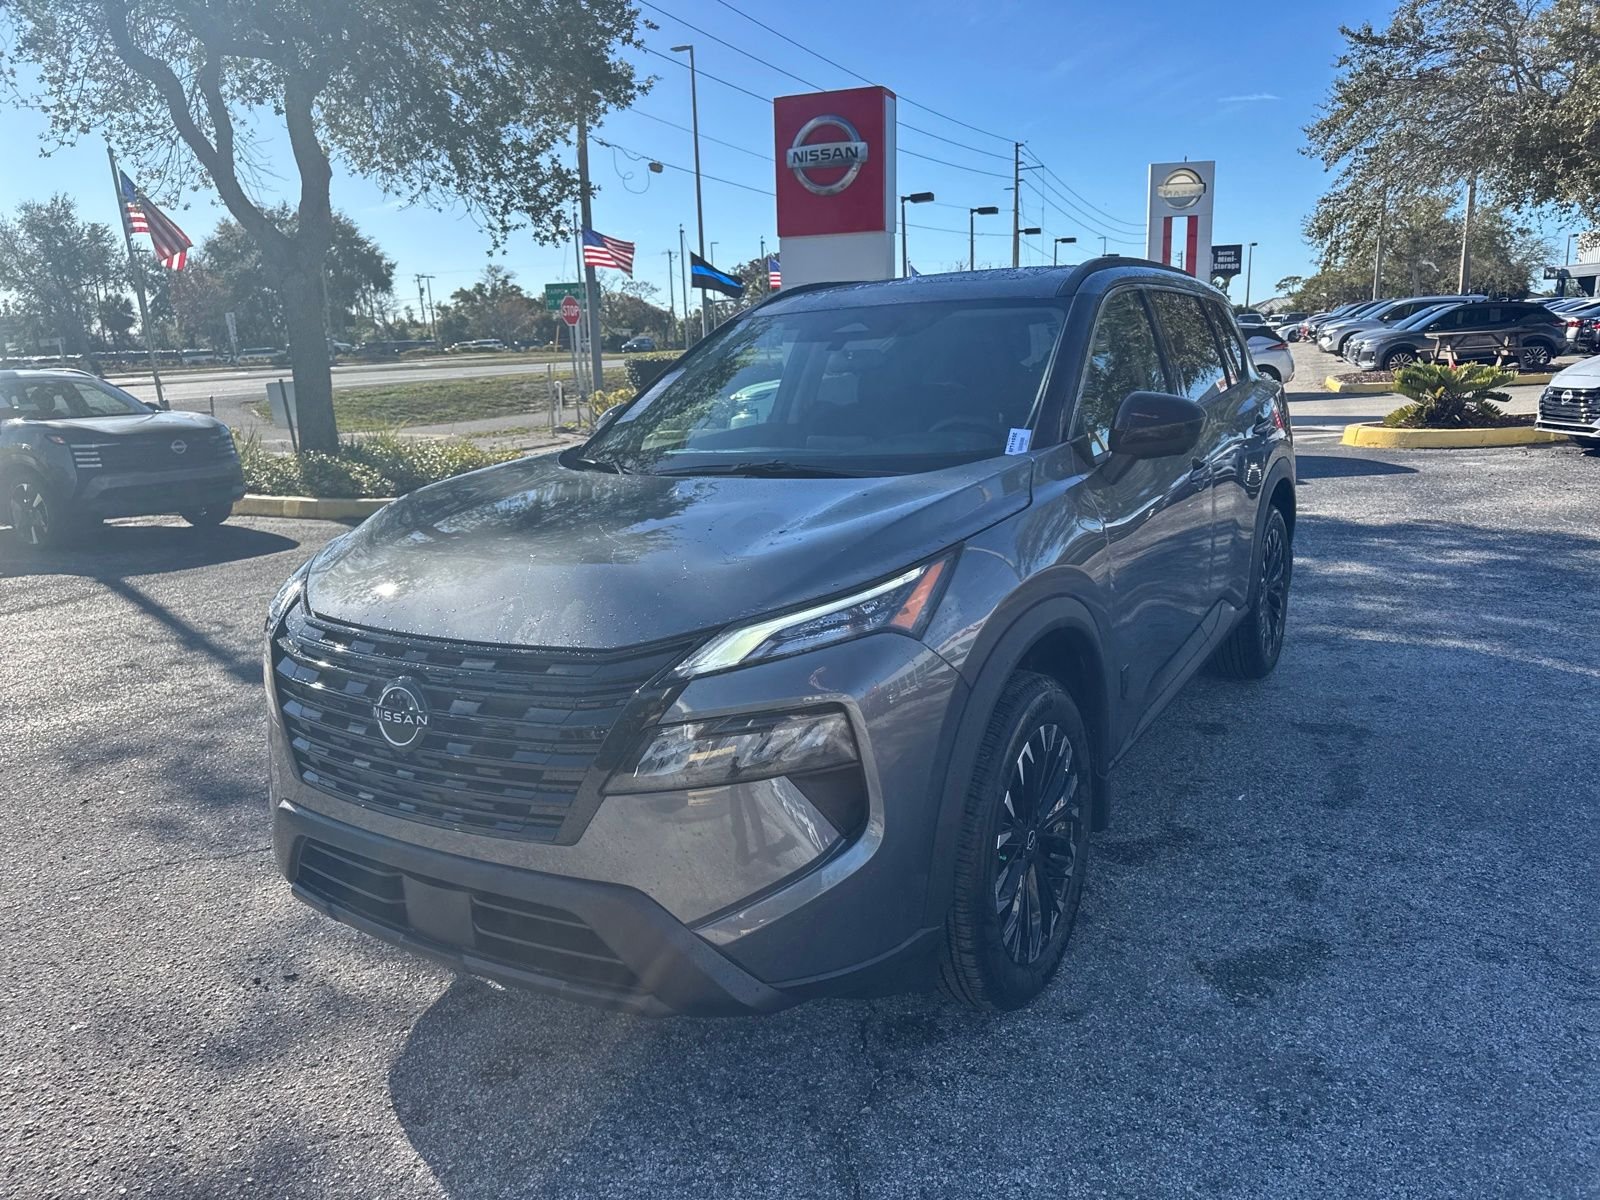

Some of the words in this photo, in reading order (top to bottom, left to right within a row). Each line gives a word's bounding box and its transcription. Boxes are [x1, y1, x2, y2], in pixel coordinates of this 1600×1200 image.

[793, 146, 858, 163] NISSAN
[1217, 255, 1237, 263] Mini-
[1213, 262, 1240, 270] Storage
[563, 305, 579, 317] STOP
[373, 706, 428, 725] NISSAN
